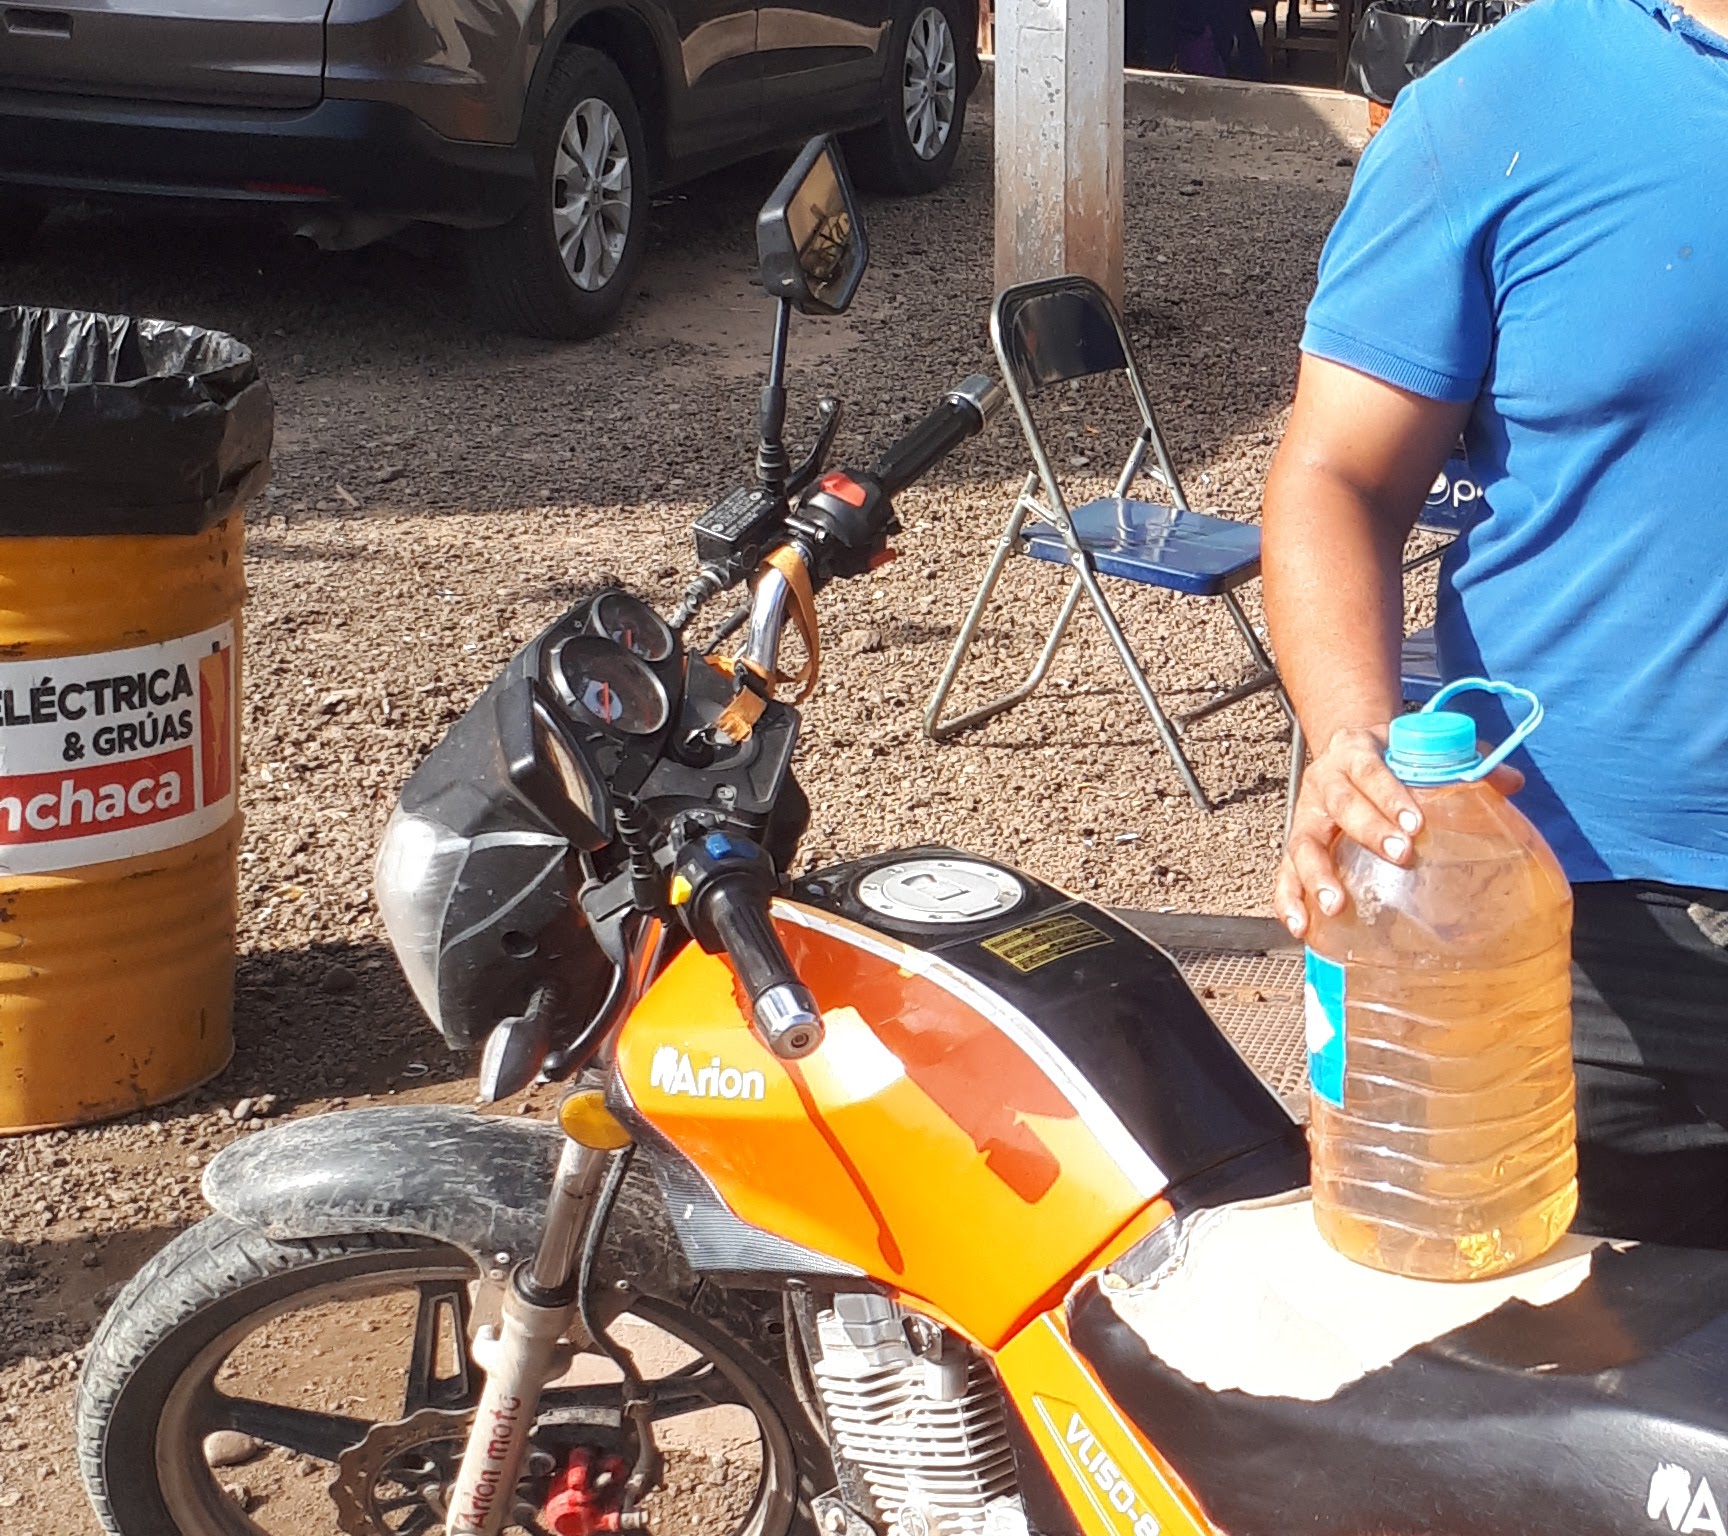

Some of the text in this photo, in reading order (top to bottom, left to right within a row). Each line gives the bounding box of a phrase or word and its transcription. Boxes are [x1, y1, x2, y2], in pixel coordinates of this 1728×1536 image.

[0, 663, 194, 727] LÉCTRICA
[62, 708, 194, 762] & GRÚAS
[669, 1051, 766, 1102] Arion
[458, 1469, 502, 1530] Arion
